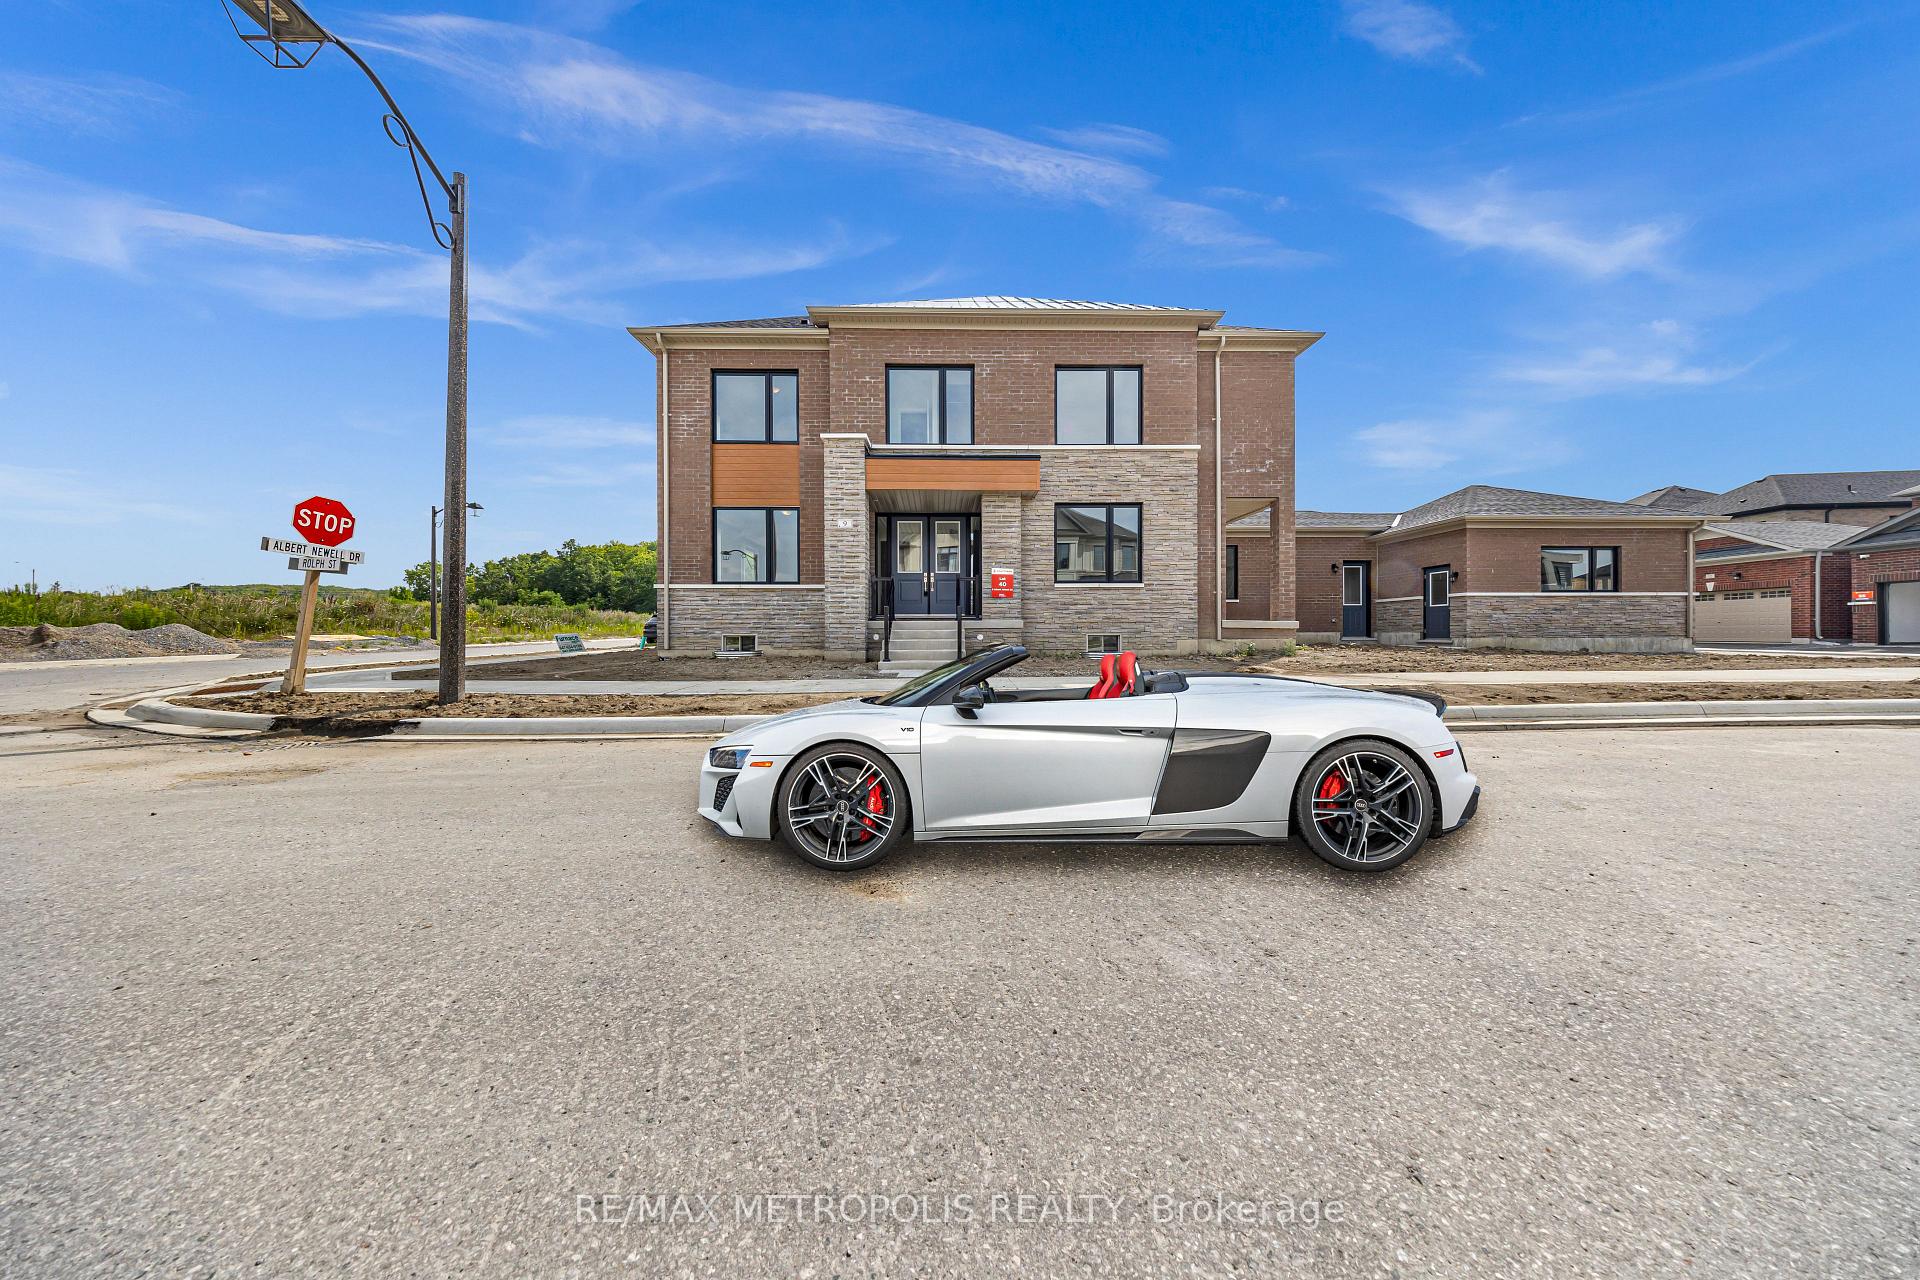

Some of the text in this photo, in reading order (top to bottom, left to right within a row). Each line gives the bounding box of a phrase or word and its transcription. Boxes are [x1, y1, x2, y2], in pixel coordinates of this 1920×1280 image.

[297, 508, 353, 534] STOP
[273, 540, 361, 562] ALBERT NEWELL DR
[302, 558, 337, 569] ROLPH ST
